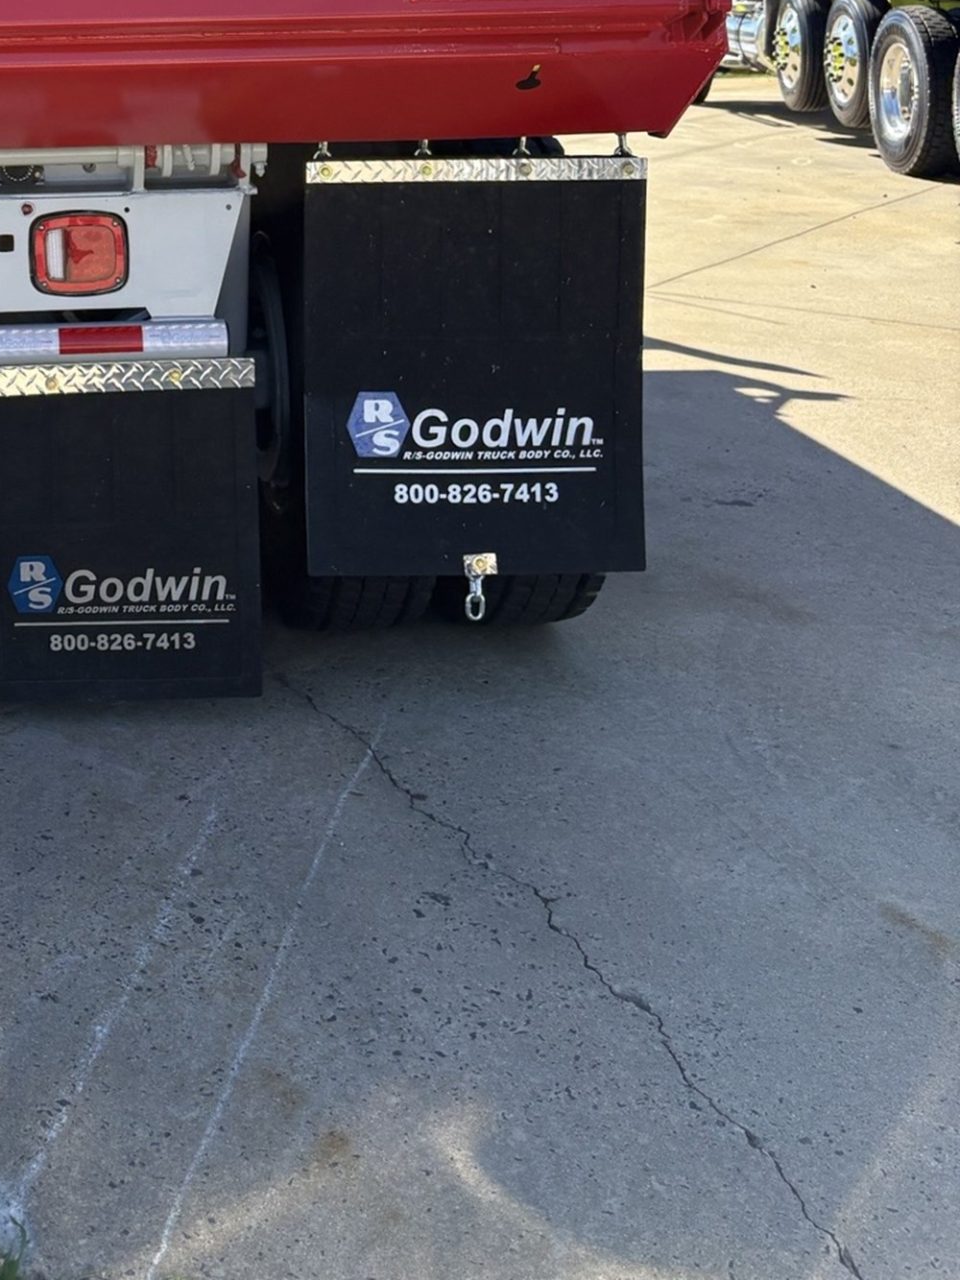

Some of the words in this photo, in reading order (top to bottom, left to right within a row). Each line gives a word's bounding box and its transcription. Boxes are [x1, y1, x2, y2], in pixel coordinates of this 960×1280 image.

[412, 407, 594, 448] Godwin
[403, 451, 473, 460] R/S-GODWIN
[477, 450, 516, 459] TRUCK
[518, 449, 551, 459] BODY
[579, 449, 603, 458] LLC.
[394, 482, 559, 504] 800-826-7413
[65, 566, 227, 604] Godwin
[57, 606, 119, 614] R/S-GODWIN
[122, 604, 157, 613] TRUCK
[160, 604, 188, 612] BODY
[50, 632, 196, 651] 800-826-7413
